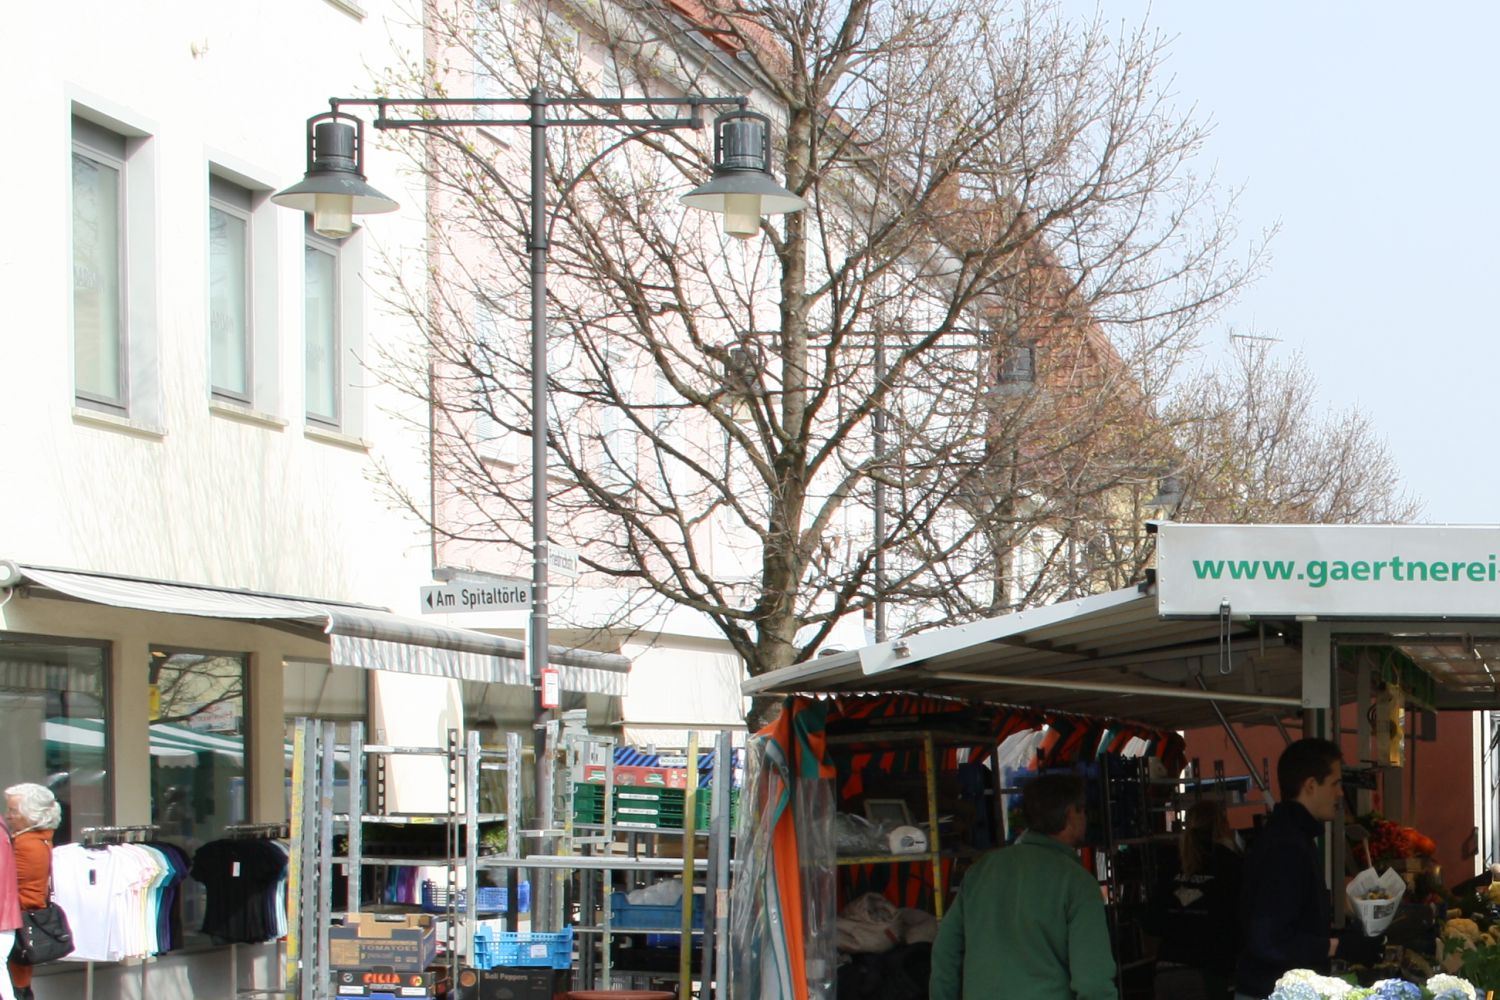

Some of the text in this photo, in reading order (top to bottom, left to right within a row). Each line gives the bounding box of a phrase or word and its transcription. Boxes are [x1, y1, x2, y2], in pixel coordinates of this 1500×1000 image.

[436, 586, 527, 609] Am Spitaltörle
[361, 944, 418, 952] TOMATOES
